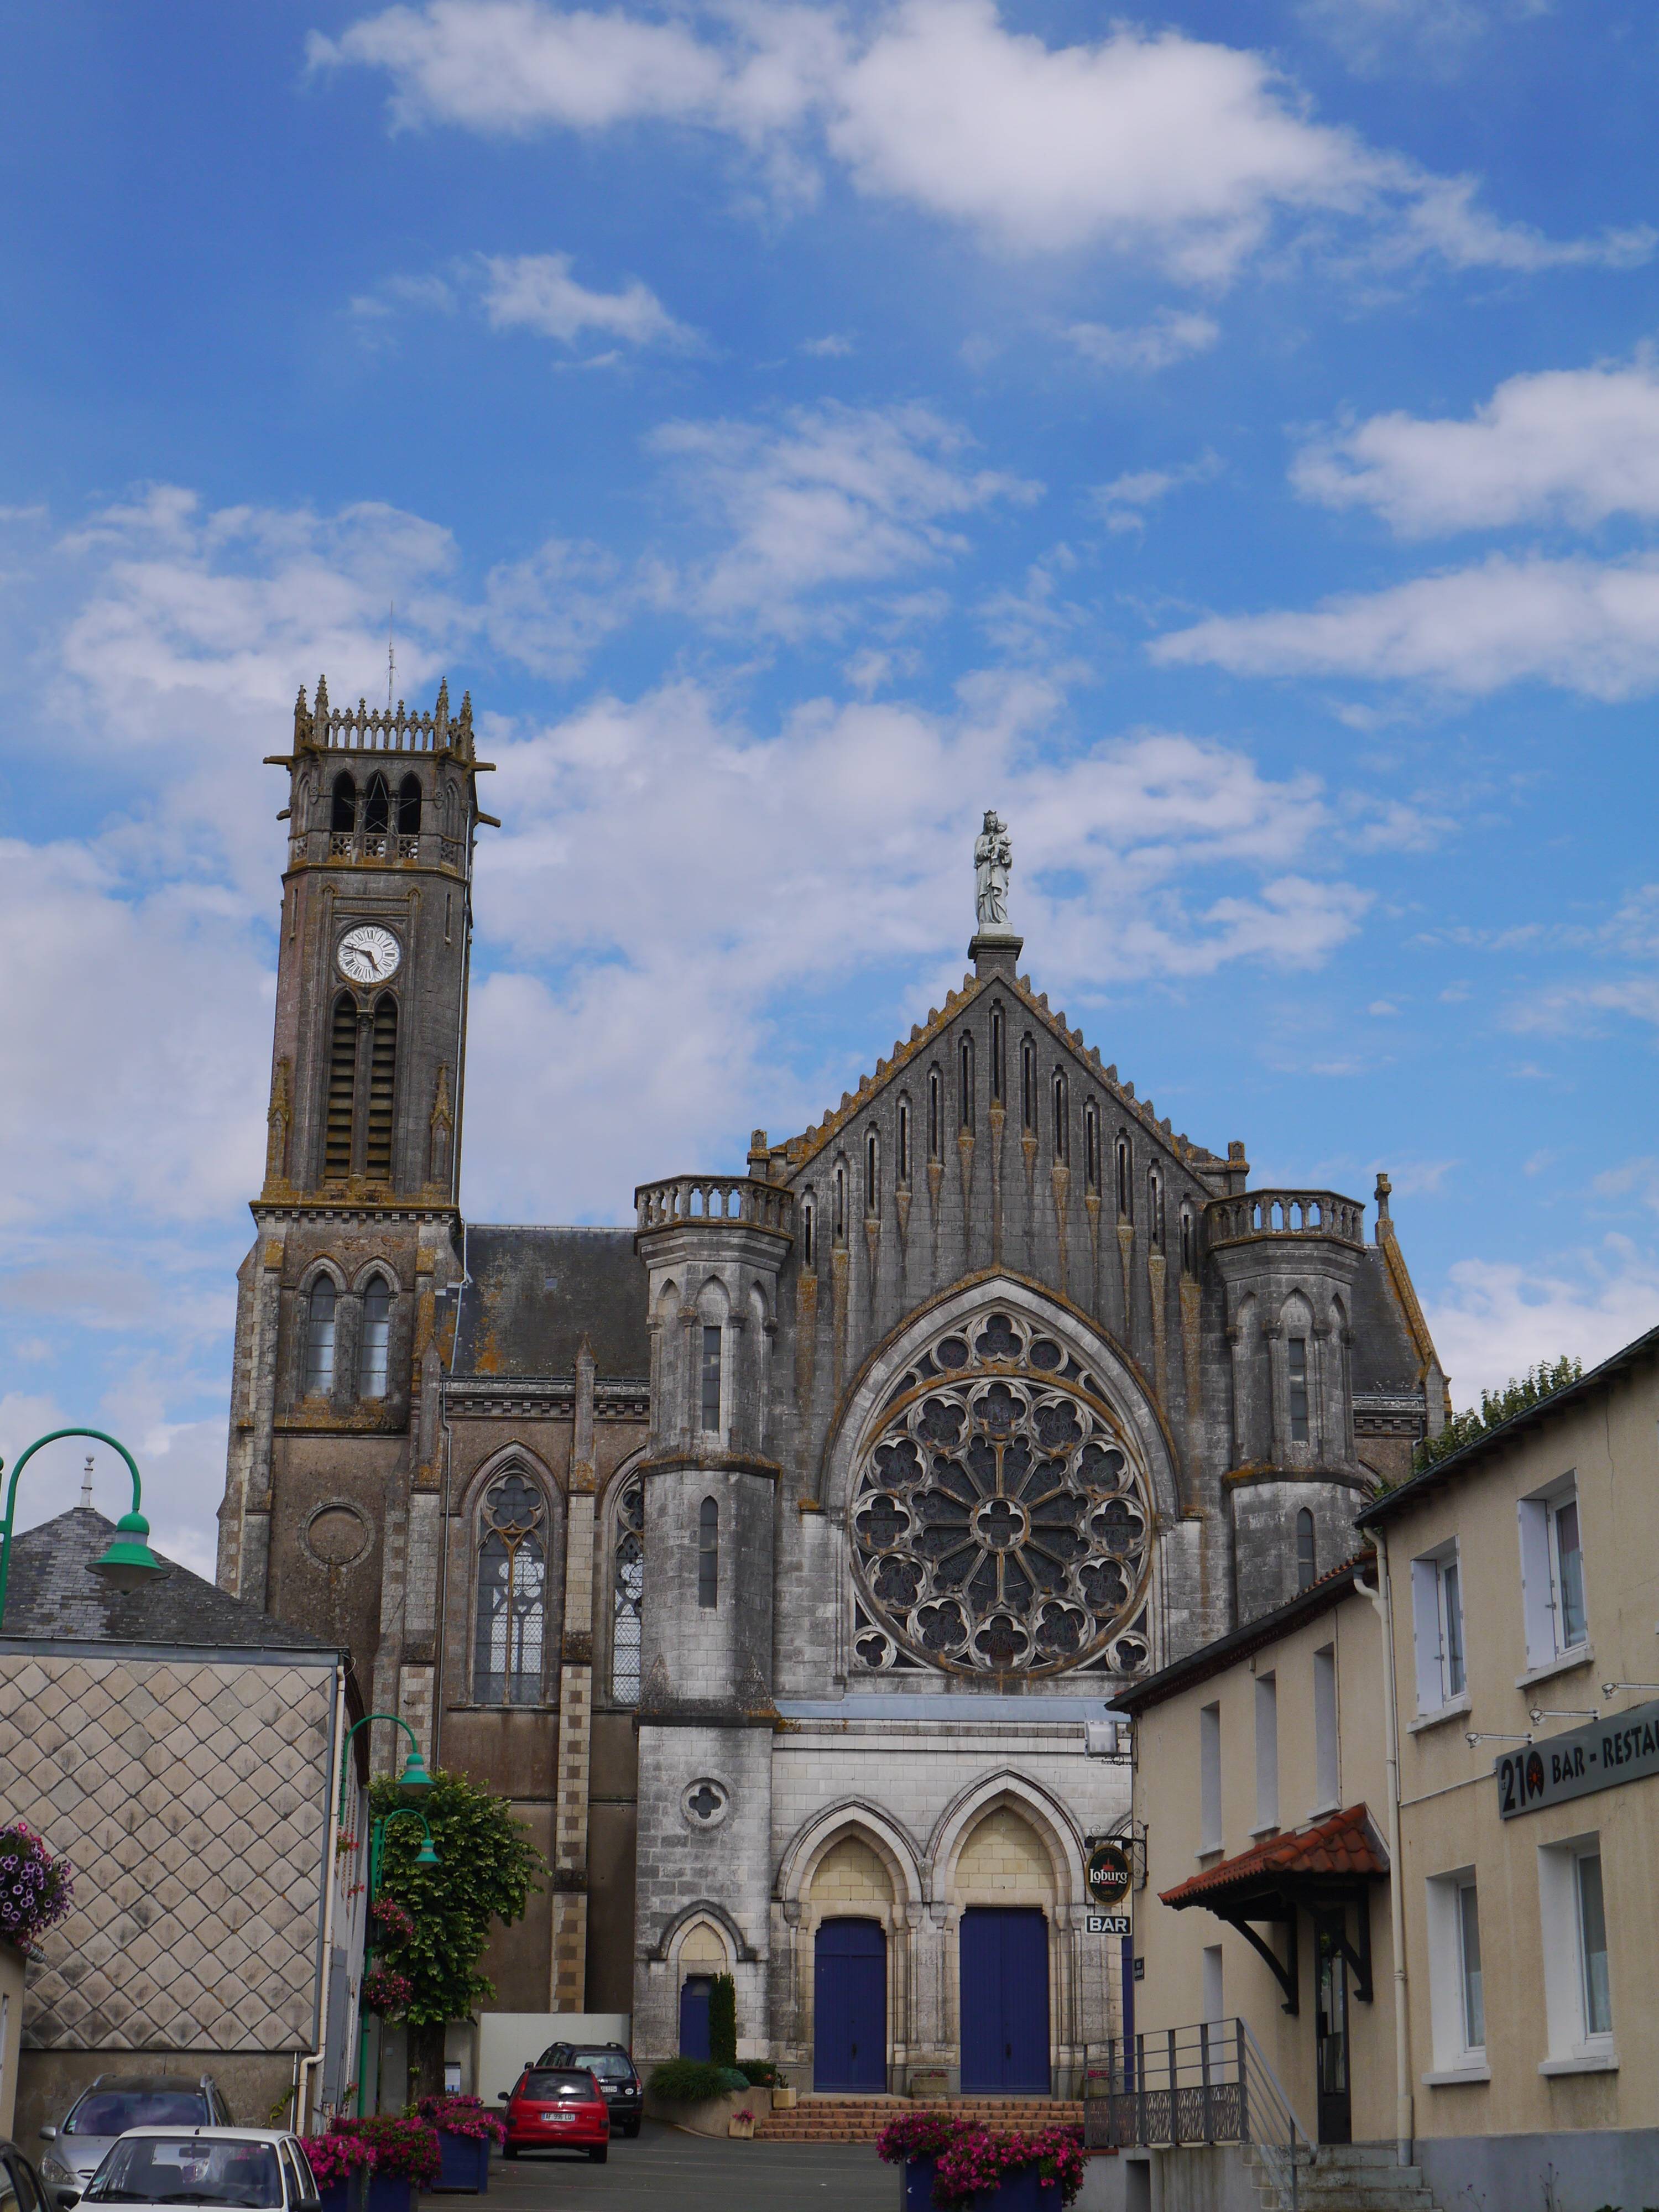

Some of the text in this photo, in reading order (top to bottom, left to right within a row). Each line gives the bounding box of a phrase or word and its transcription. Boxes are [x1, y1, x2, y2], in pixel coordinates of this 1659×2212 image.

[1552, 1746, 1585, 1785] BAR
[1089, 1869, 1128, 1885] Loburg
[1089, 1917, 1127, 1932] BAR
